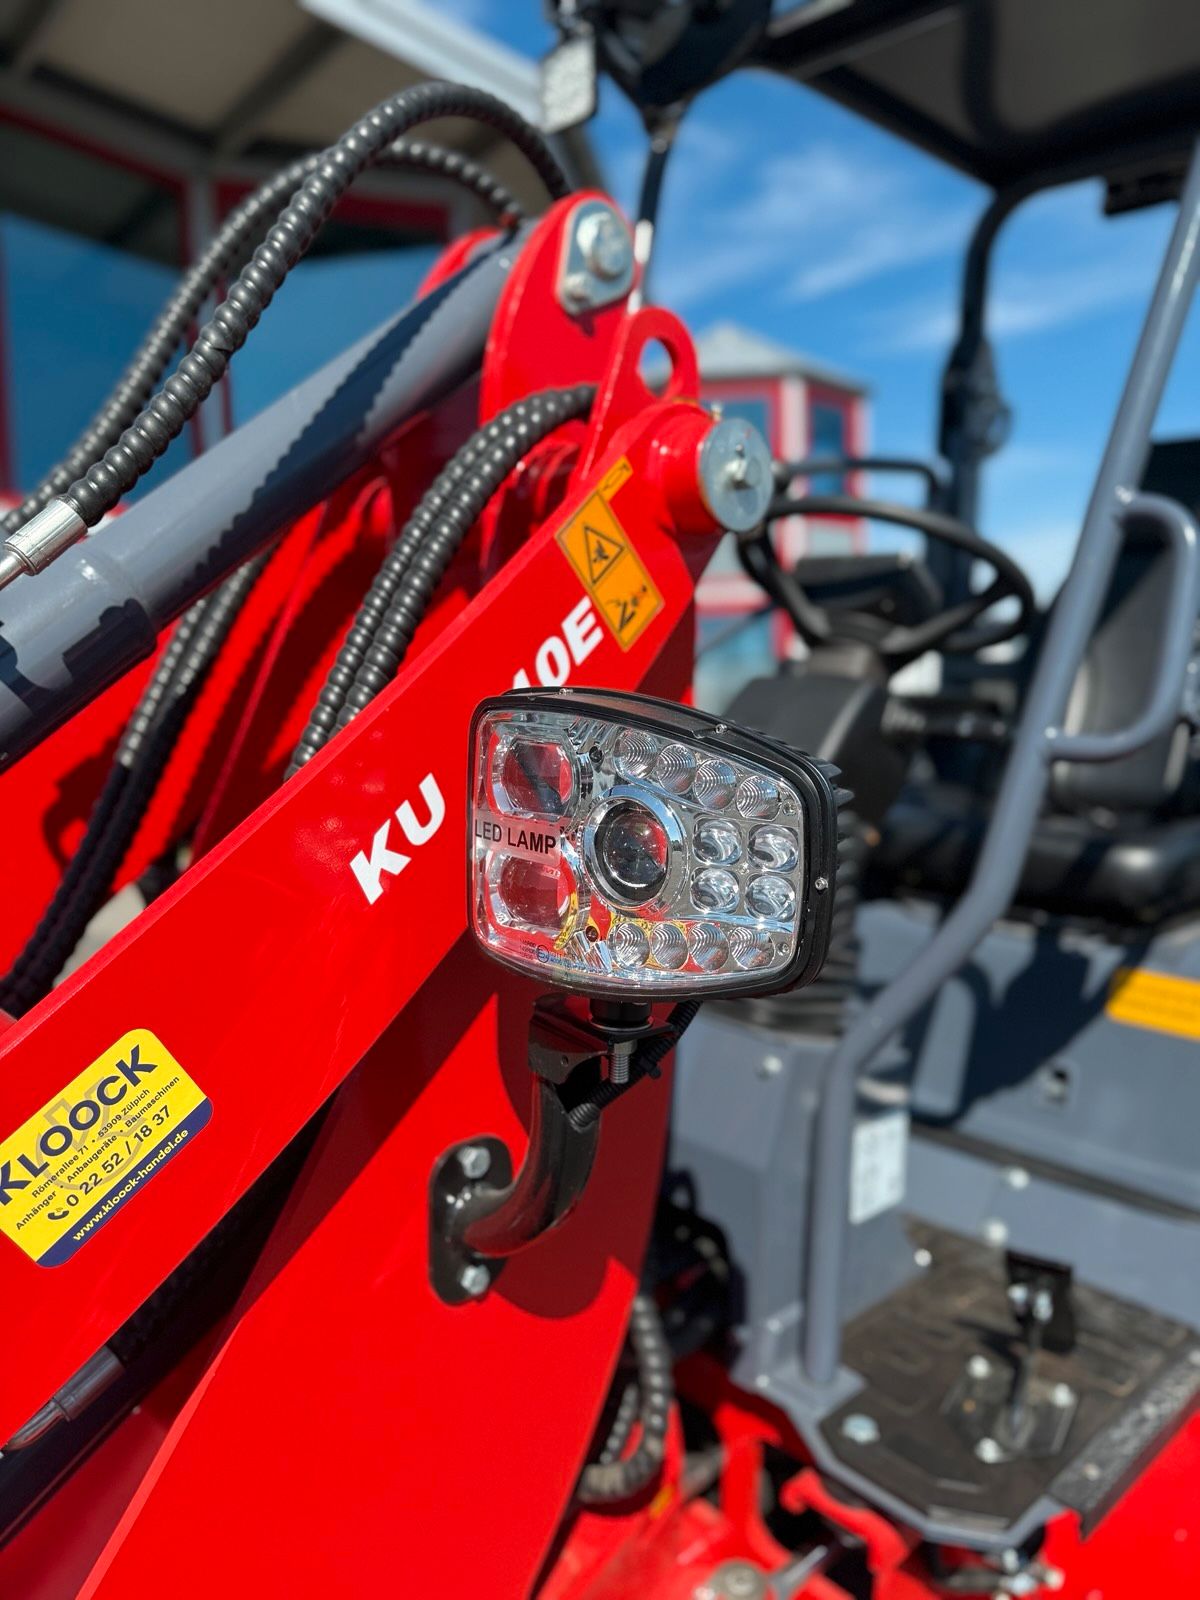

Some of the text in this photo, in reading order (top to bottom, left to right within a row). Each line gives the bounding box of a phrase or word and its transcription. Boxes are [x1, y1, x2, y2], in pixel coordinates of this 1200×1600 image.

[350, 772, 445, 905] KU
[475, 819, 556, 854] LED LAMP
[0, 1044, 158, 1206] KLOOCK
[16, 1076, 180, 1230] Anhänger Anbaugeräte Baumaschinen
[31, 1089, 150, 1199] Römerallee 71 53909 Zülpich
[66, 1194, 79, 1207] 0
[80, 1173, 103, 1195] 22
[102, 1152, 124, 1174] 52
[133, 1125, 153, 1143] 18
[152, 1104, 171, 1126] 37
[73, 1129, 189, 1241] www.kloock-handel.de
